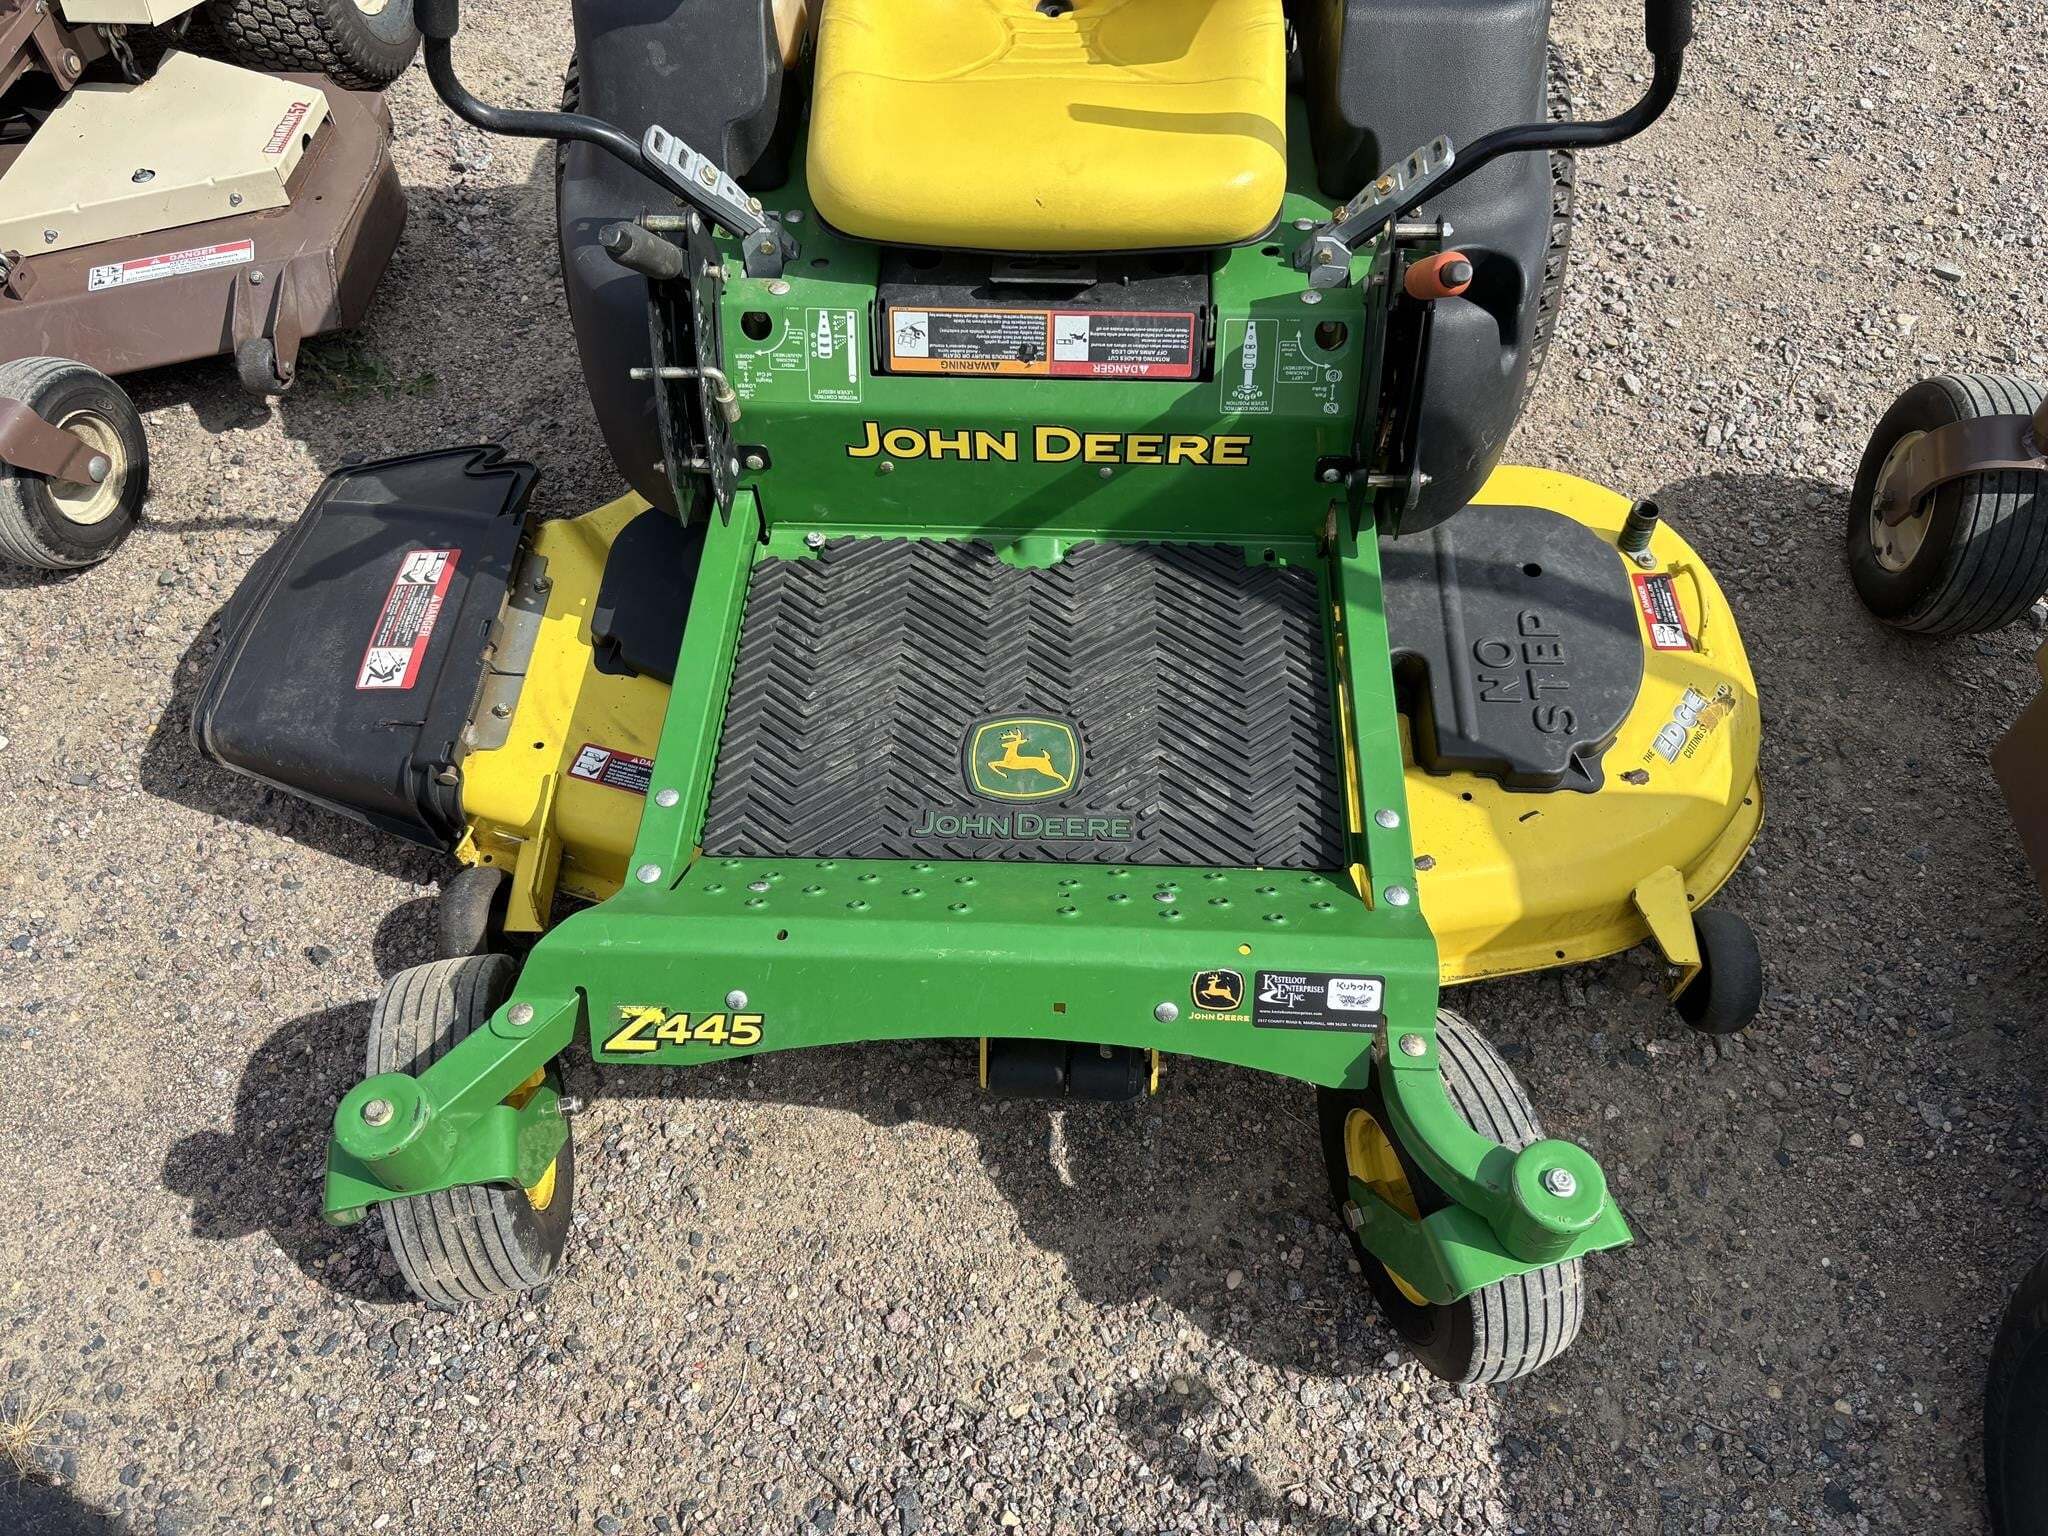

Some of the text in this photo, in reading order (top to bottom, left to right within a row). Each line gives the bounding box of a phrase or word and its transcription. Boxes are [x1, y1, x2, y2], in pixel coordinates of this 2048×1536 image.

[169, 248, 216, 261] DANGER
[941, 361, 989, 370] WARNING
[1092, 364, 1138, 374] DANGER
[846, 420, 1252, 465] JOHN DEERE
[1473, 637, 1522, 703] NO
[1517, 608, 1578, 735] STEP
[1652, 688, 1709, 764] EDGE
[1643, 748, 1655, 763] THE
[914, 810, 1132, 839] JOHN DEERE
[1262, 974, 1307, 990] KESTELOOT
[1336, 982, 1374, 992] Kubota
[1276, 984, 1325, 999] ENTERPRISES
[1188, 1011, 1250, 1022] JOHN DEERE
[601, 1004, 764, 1053] Z445
